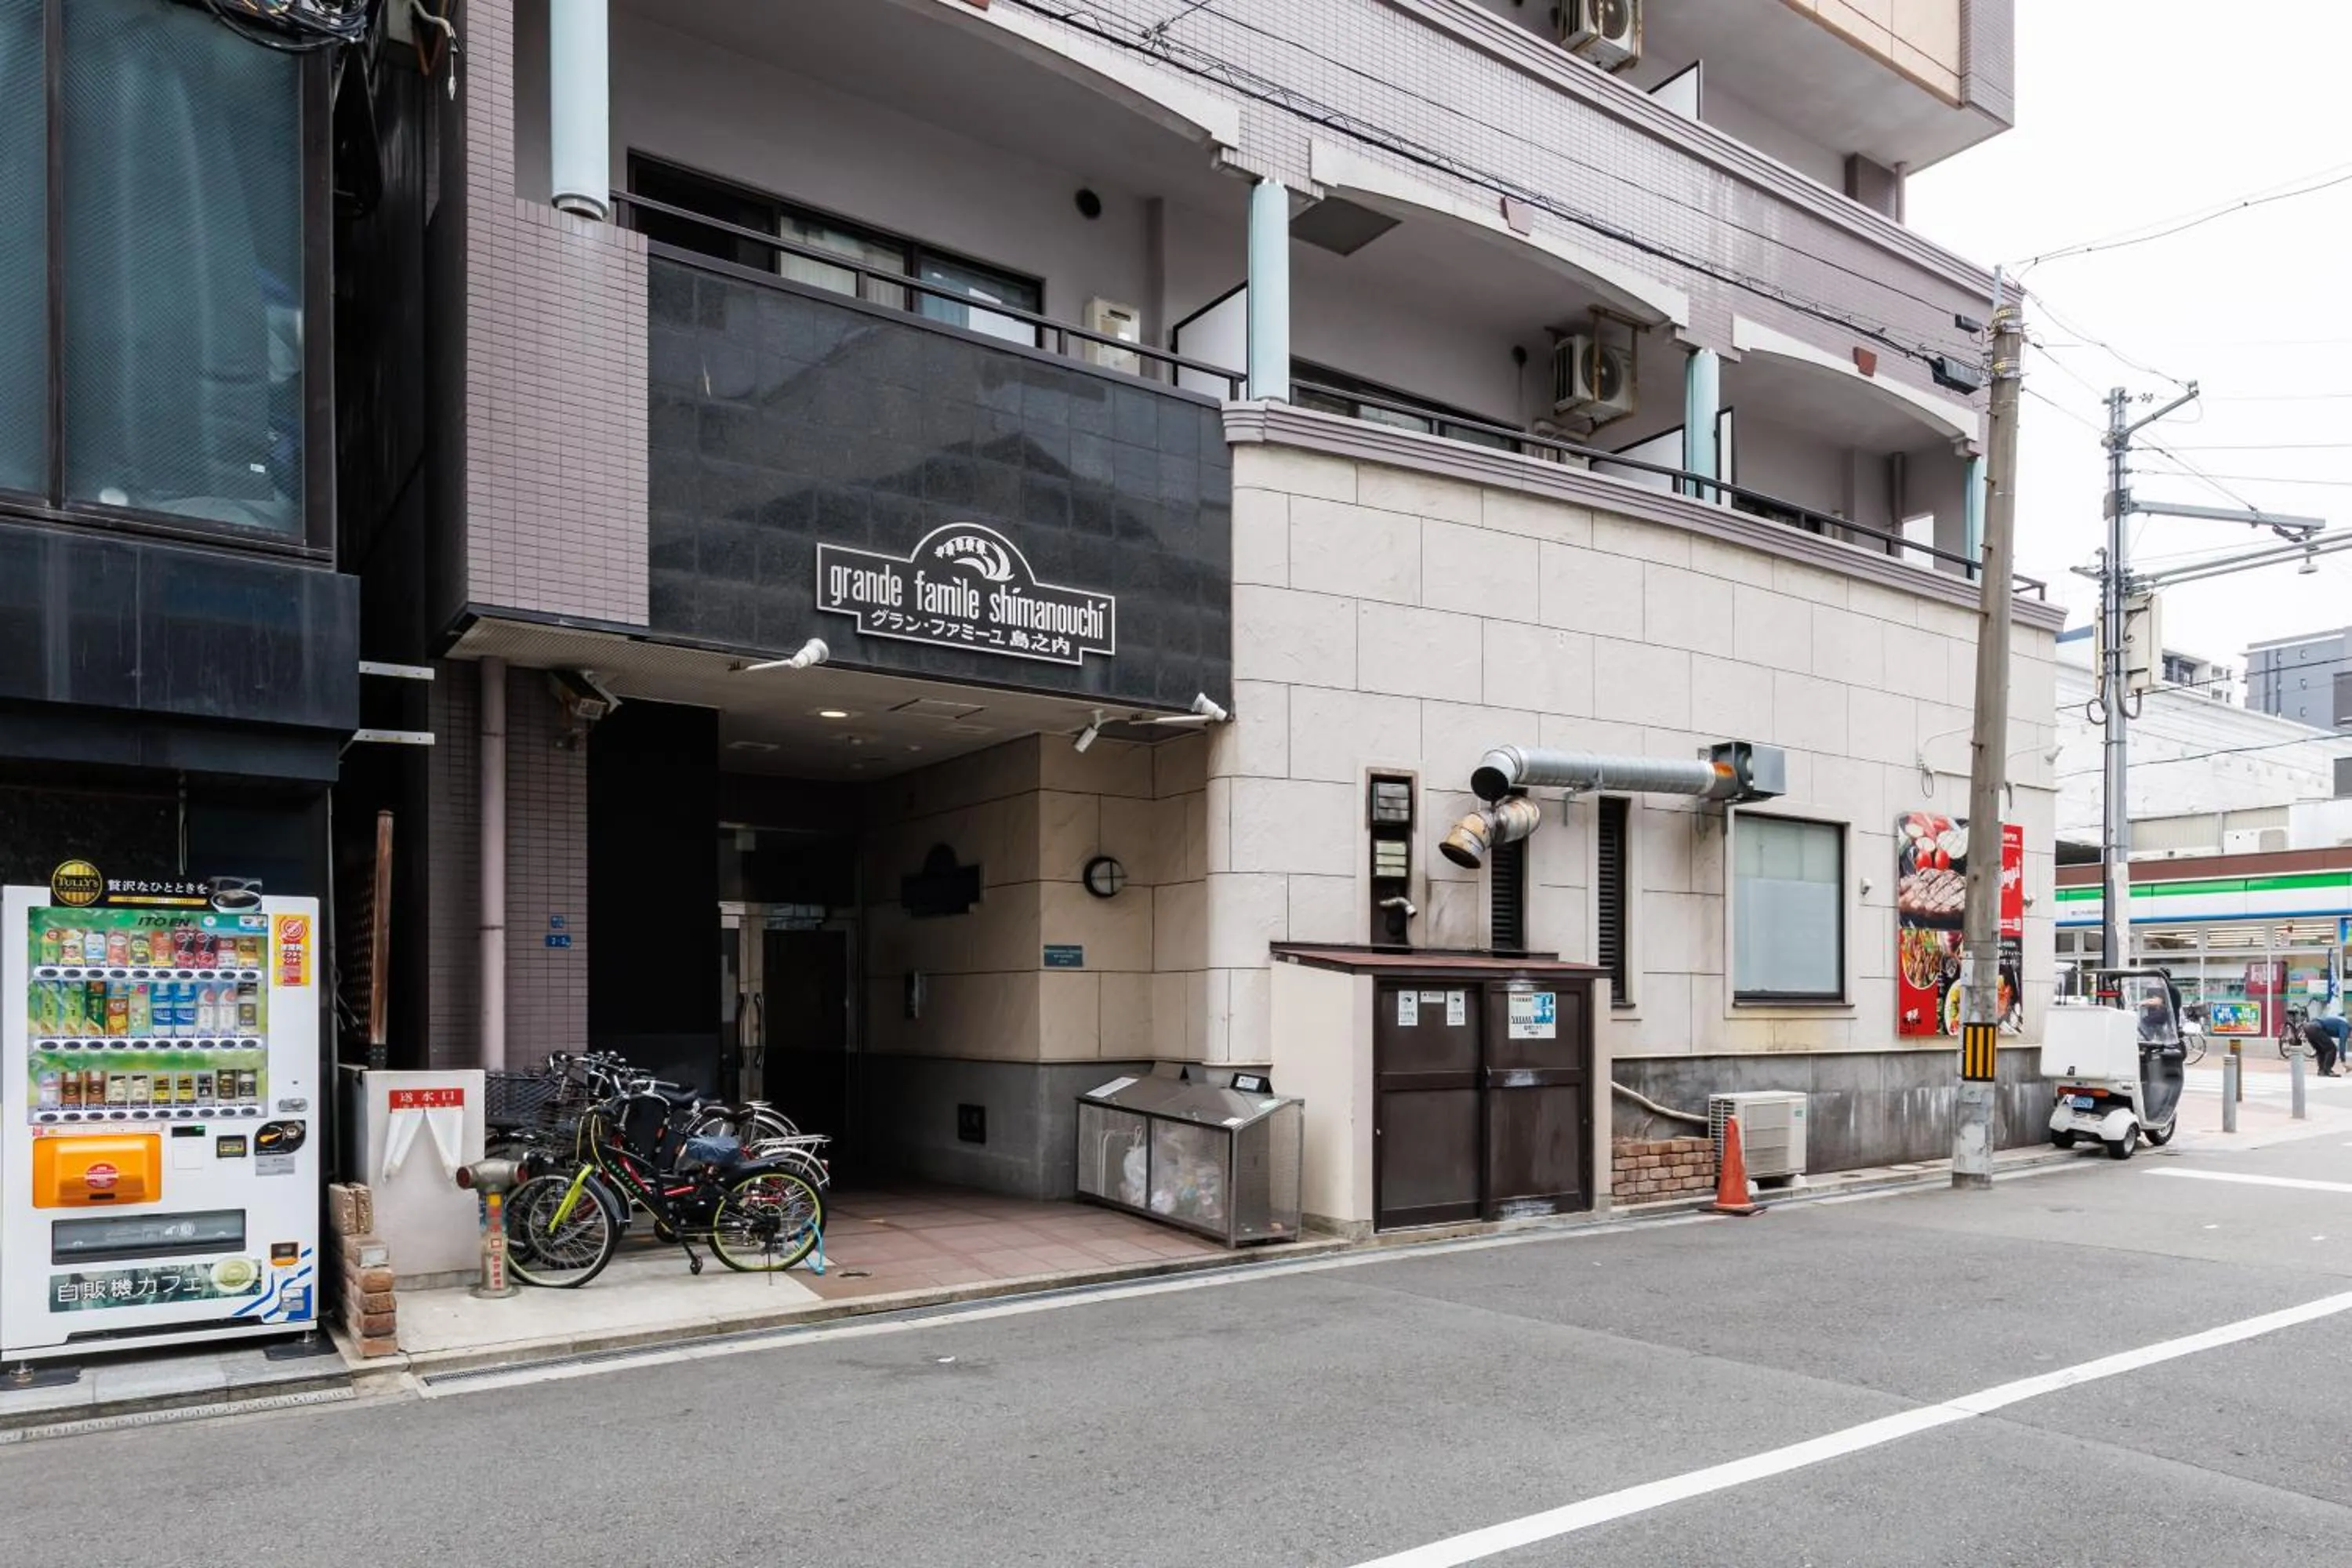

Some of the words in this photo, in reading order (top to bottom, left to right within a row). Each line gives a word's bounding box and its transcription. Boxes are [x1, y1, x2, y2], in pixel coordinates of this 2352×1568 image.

[829, 564, 902, 607] grande
[914, 570, 979, 620] famile
[989, 584, 1107, 640] shimanouchi
[870, 608, 1006, 645] グラン・ファミーユ
[1009, 630, 1071, 655] 島之内
[138, 916, 167, 927] ITO
[169, 917, 191, 927] EN
[57, 1274, 201, 1302] 自販機カフェ
